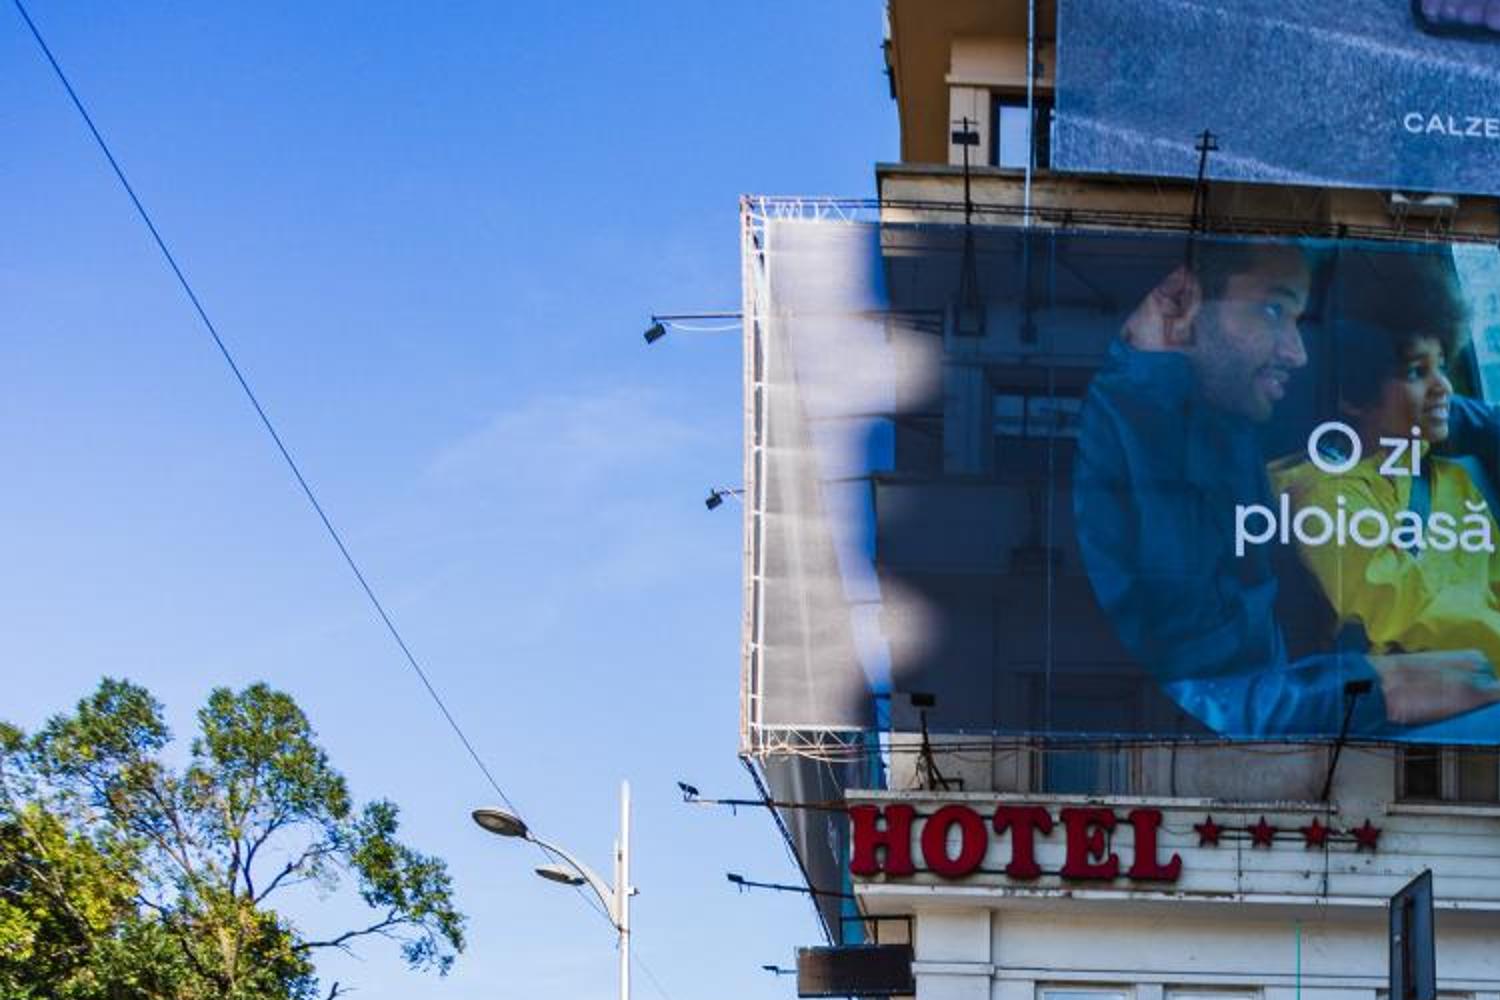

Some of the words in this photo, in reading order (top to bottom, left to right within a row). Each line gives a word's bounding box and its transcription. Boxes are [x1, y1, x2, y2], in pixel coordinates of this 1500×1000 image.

[1307, 422, 1362, 474] O
[1379, 427, 1421, 477] zi
[1235, 494, 1494, 557] ploioasă
[849, 804, 1182, 882] HOTEL
